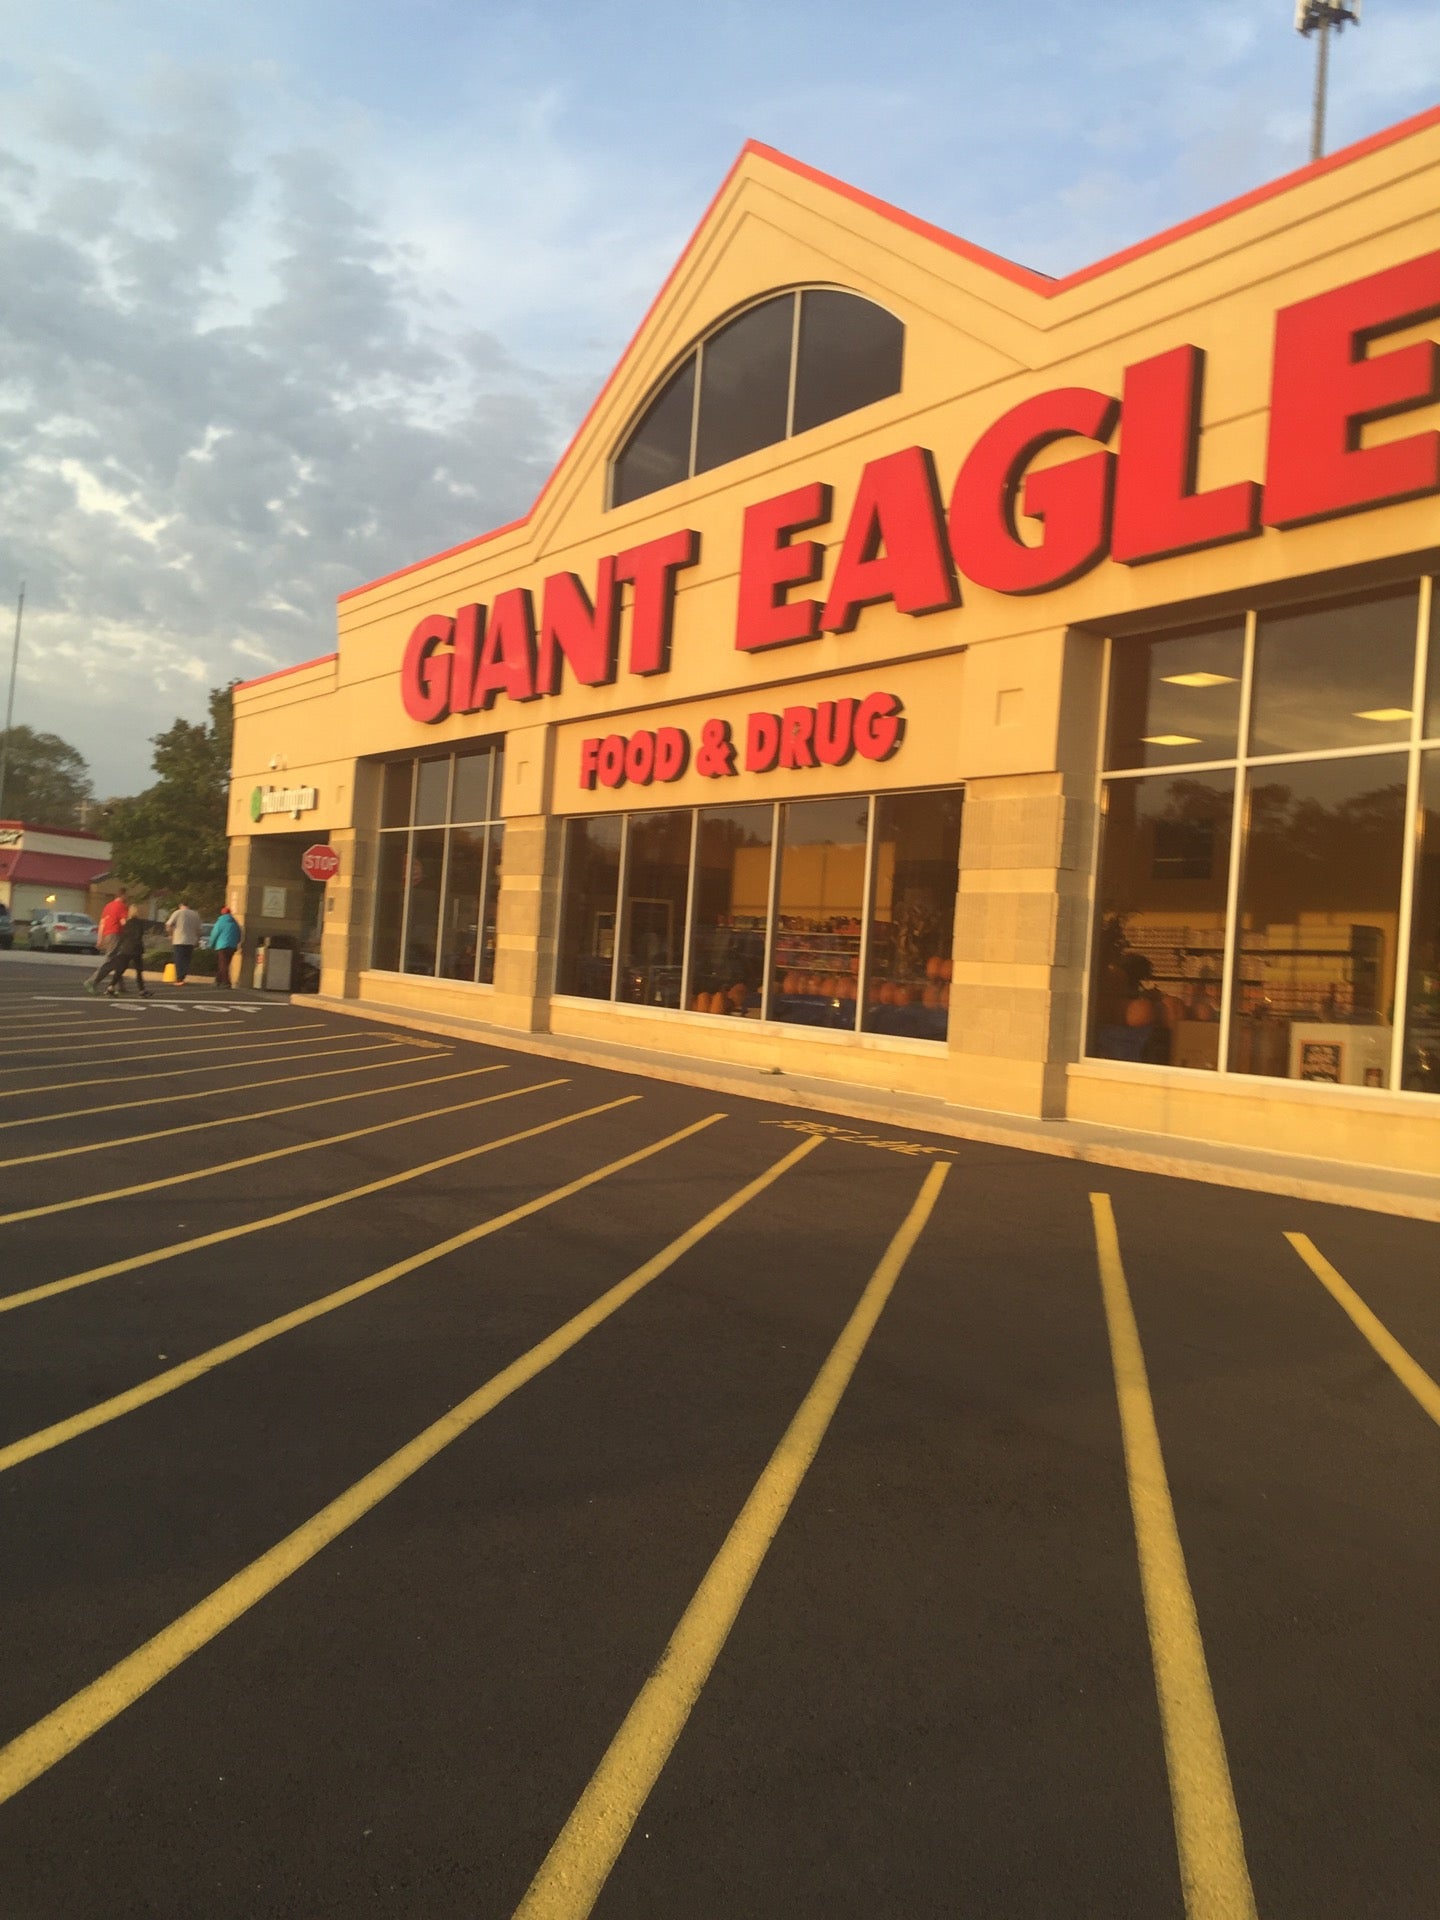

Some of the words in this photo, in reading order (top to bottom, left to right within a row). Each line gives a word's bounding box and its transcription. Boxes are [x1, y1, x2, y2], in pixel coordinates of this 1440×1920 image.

[401, 528, 701, 724] GIANT
[735, 250, 1440, 656] EAGLE
[579, 726, 690, 790] FOOD
[696, 718, 738, 778] &
[746, 691, 906, 773] DRUG
[303, 855, 339, 871] STOP
